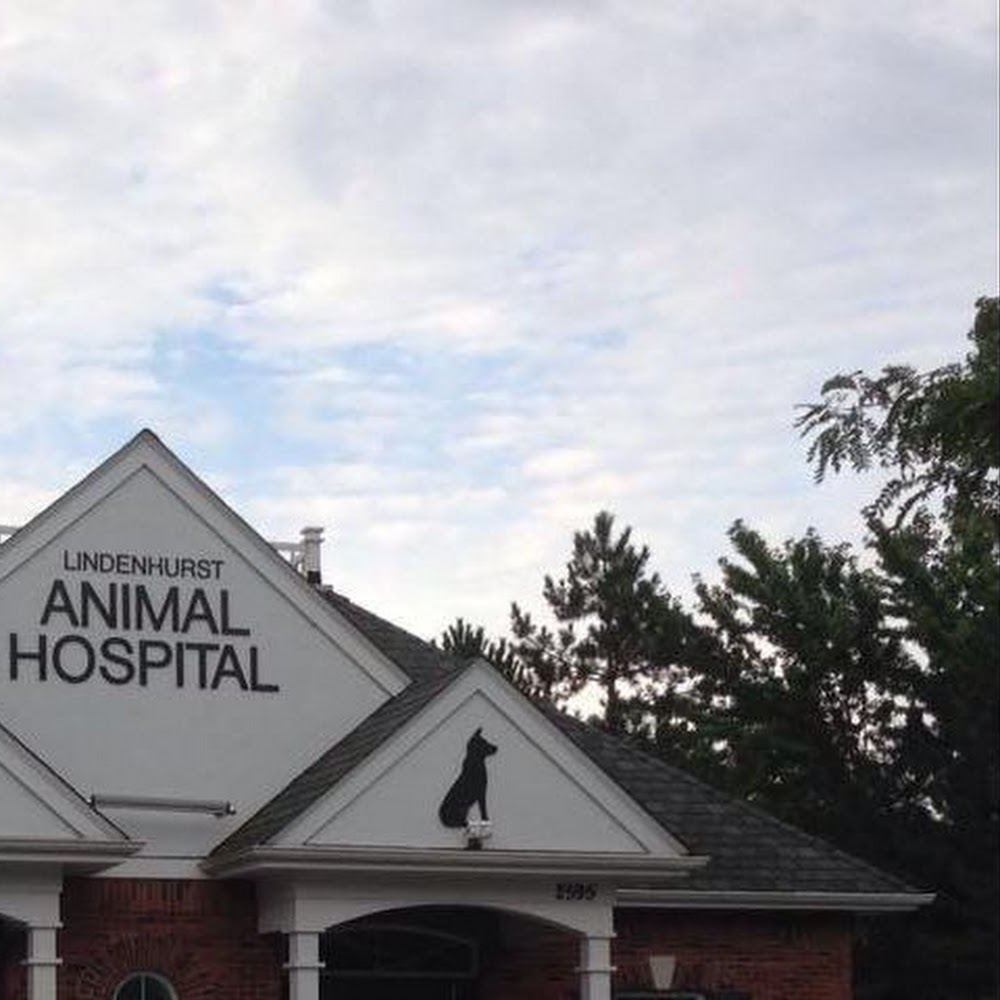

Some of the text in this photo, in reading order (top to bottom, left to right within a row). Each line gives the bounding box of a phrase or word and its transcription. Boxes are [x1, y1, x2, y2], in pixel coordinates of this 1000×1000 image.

[63, 550, 224, 579] LINDENHURST
[40, 579, 250, 636] ANIMAL
[9, 633, 280, 692] HOSPITAL
